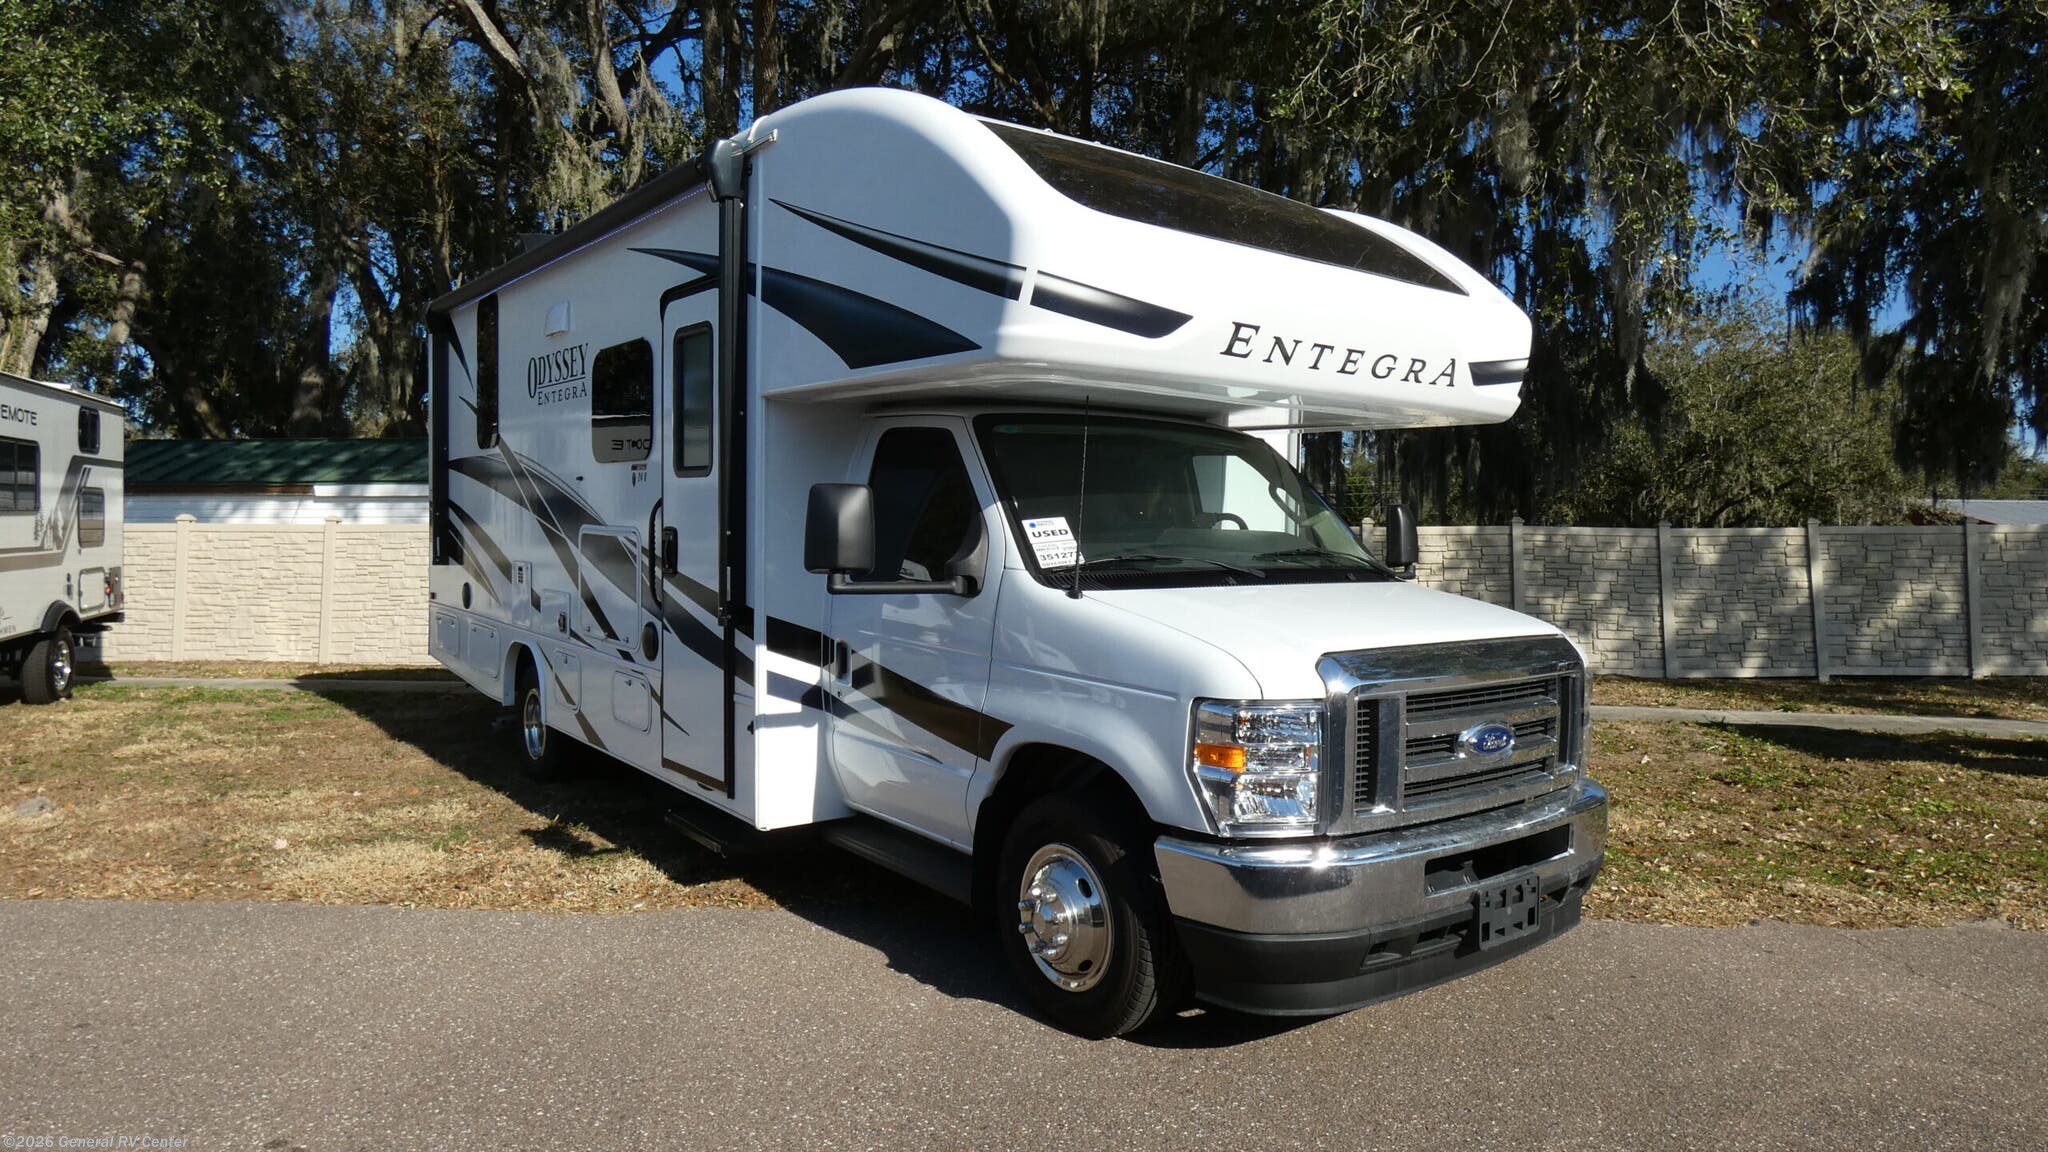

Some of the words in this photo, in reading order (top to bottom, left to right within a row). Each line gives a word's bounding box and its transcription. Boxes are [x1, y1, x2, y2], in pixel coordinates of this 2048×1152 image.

[527, 342, 589, 399] ODYSSEY
[1220, 321, 1457, 387] ENTEGRA
[537, 381, 588, 406] ENTEGRA
[1031, 528, 1069, 538] USED
